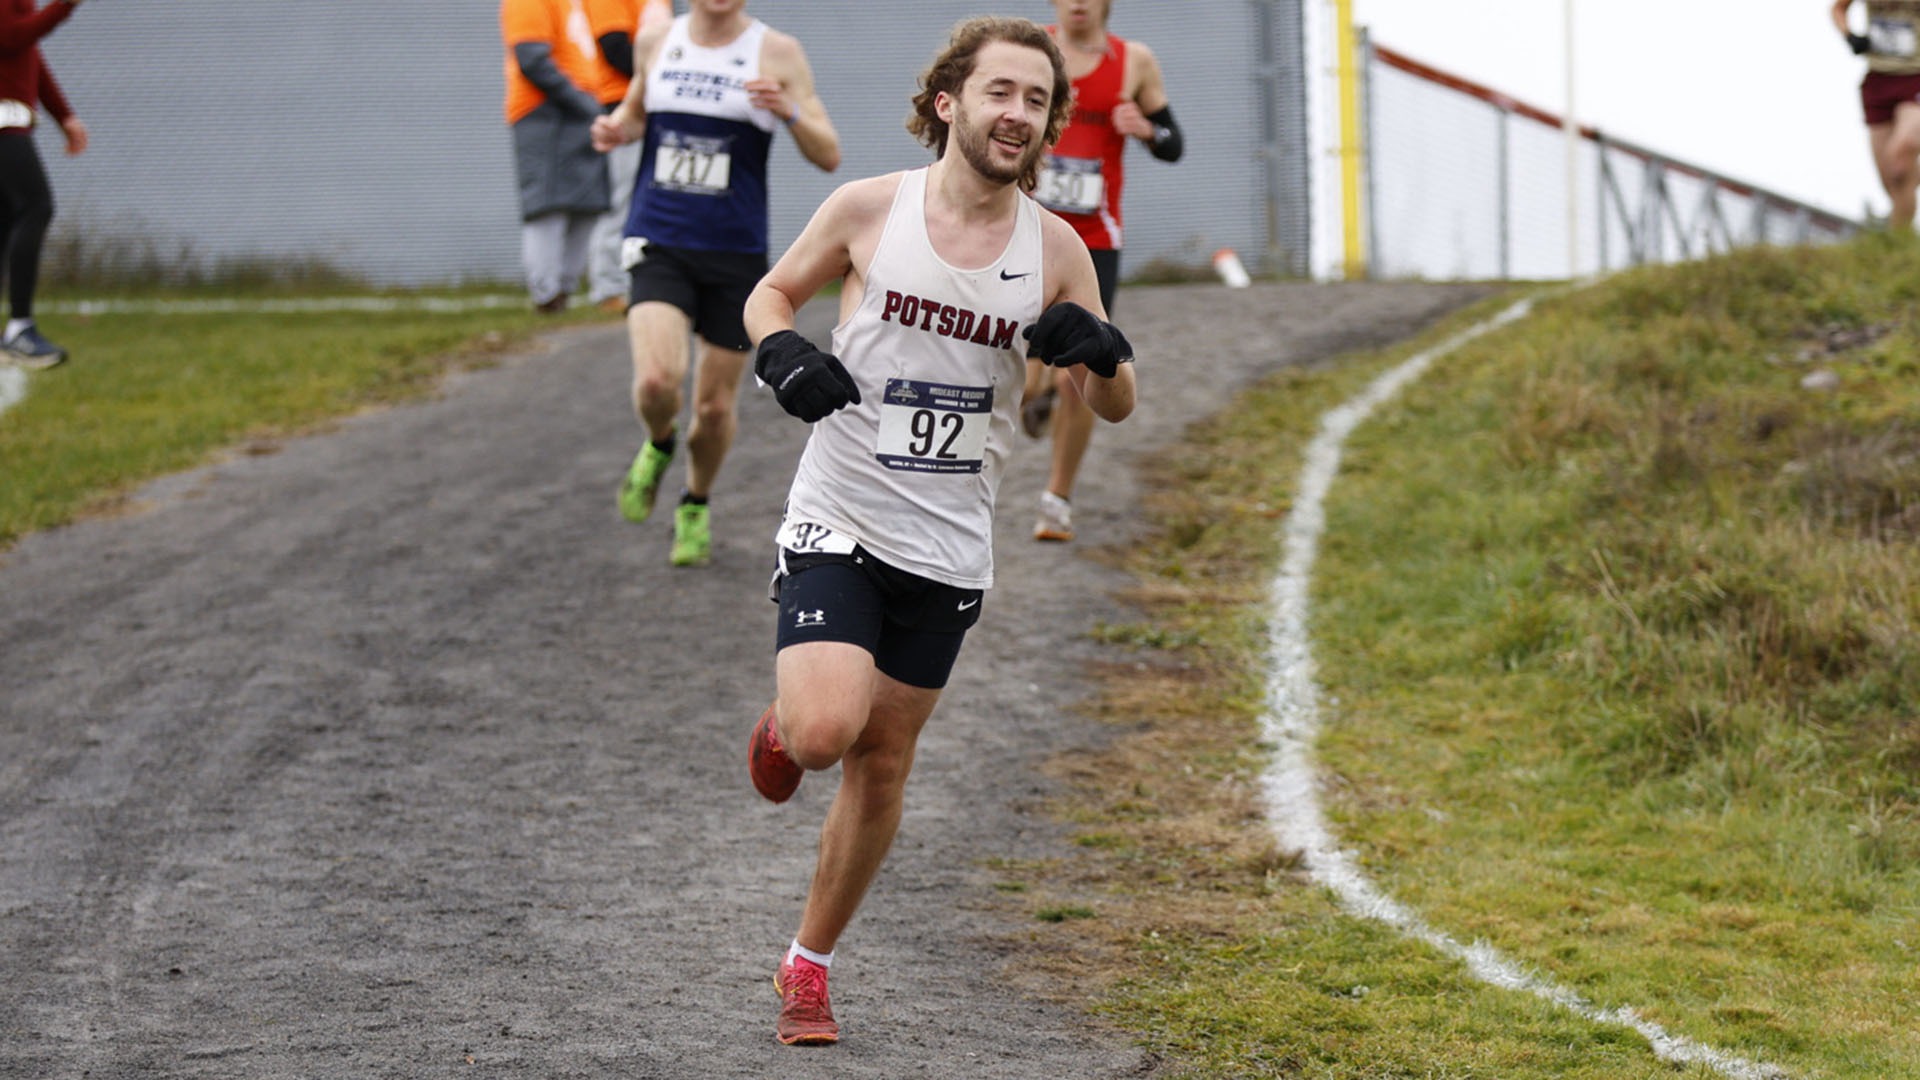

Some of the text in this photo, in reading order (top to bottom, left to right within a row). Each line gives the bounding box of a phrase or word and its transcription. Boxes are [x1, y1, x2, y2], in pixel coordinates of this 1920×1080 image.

[670, 151, 714, 185] 217
[1050, 172, 1084, 206] 50
[881, 289, 1019, 350] POTSDAM
[909, 409, 964, 459] 92
[792, 522, 832, 552] 92
